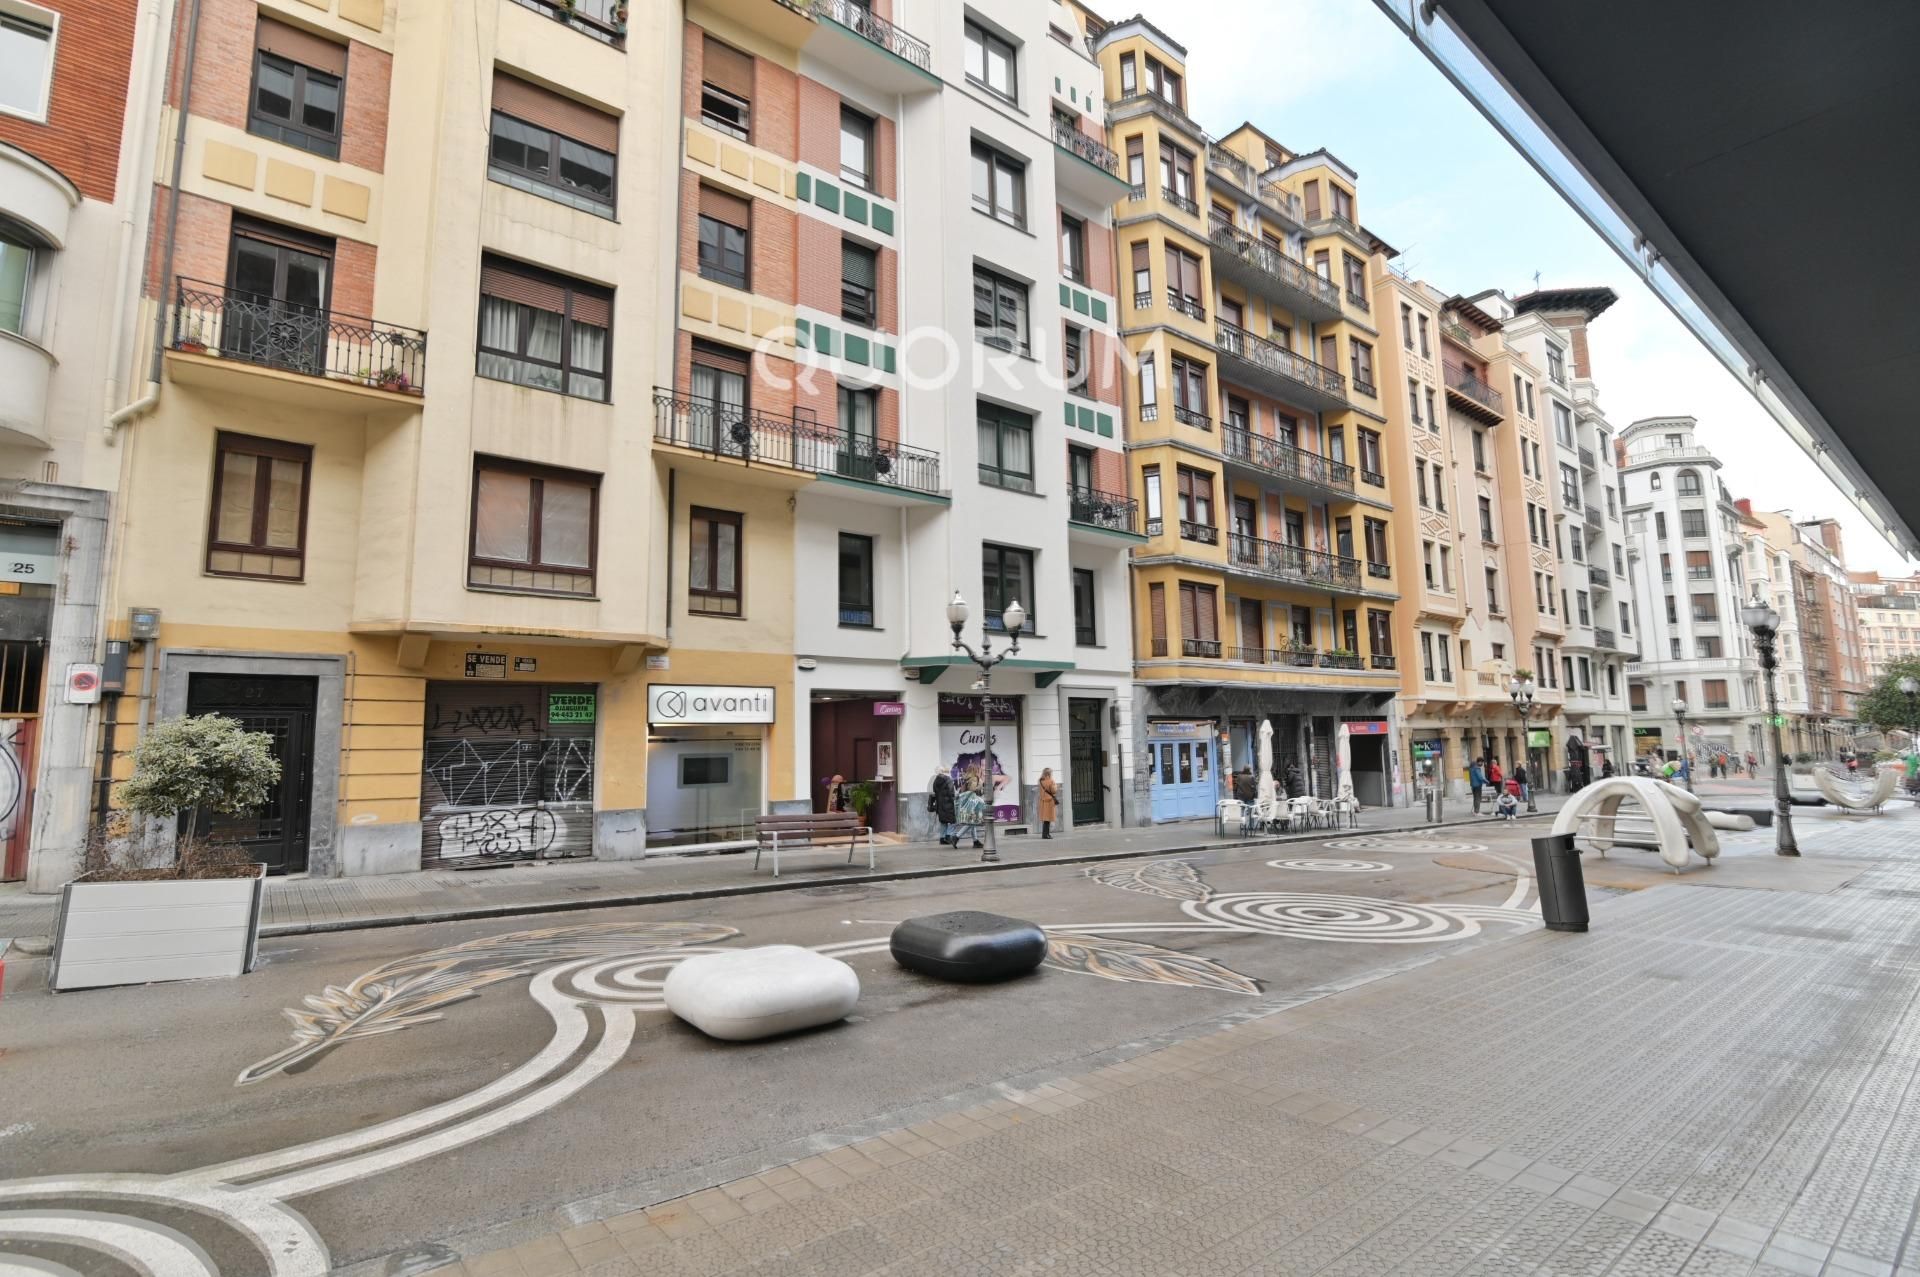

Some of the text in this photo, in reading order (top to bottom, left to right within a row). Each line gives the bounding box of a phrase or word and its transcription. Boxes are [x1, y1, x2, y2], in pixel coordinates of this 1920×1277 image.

[13, 562, 35, 574] 25
[467, 654, 477, 663] SE
[480, 655, 506, 664] VENDE
[551, 695, 593, 705] VENDE
[693, 690, 767, 712] avanti
[960, 729, 997, 745] Curvs
